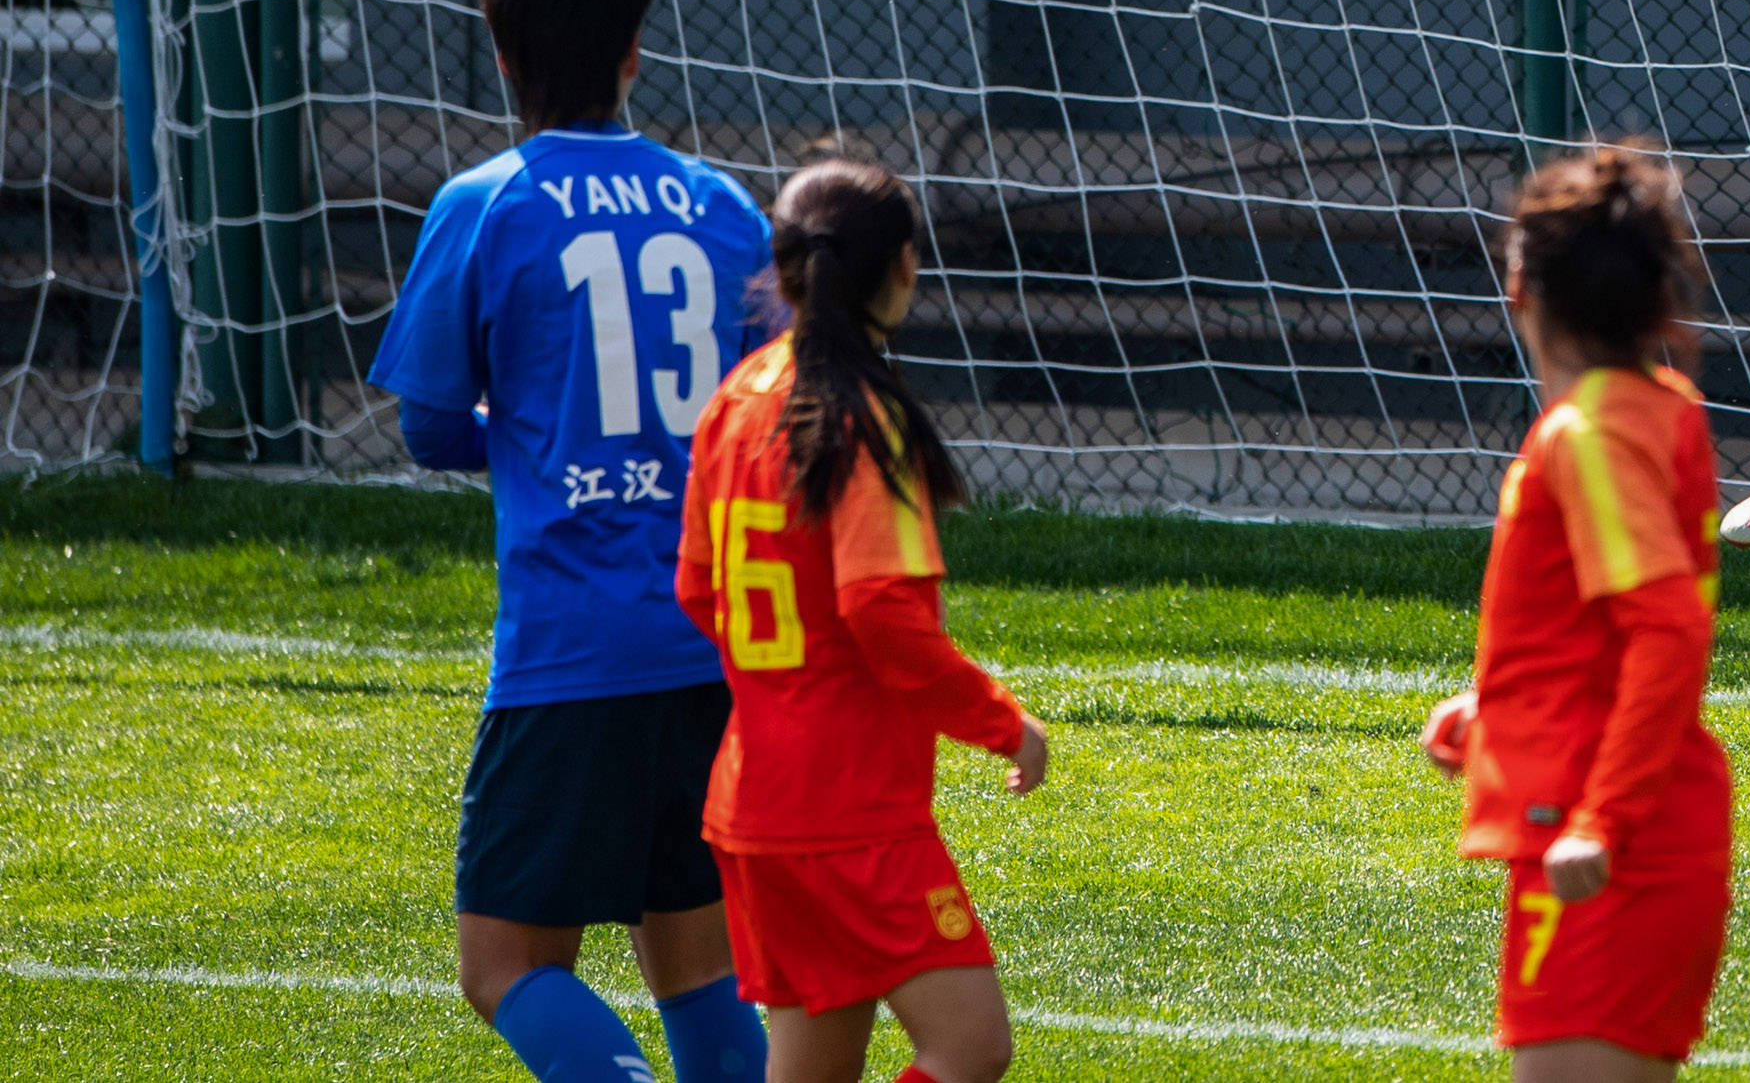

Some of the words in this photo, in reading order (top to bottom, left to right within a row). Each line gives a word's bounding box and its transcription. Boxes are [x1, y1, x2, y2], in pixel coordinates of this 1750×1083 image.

[539, 174, 651, 219] YAN
[656, 174, 706, 226] Q.
[559, 230, 721, 437] 13
[562, 459, 675, 510] 江汉
[1518, 892, 1564, 986] 7
